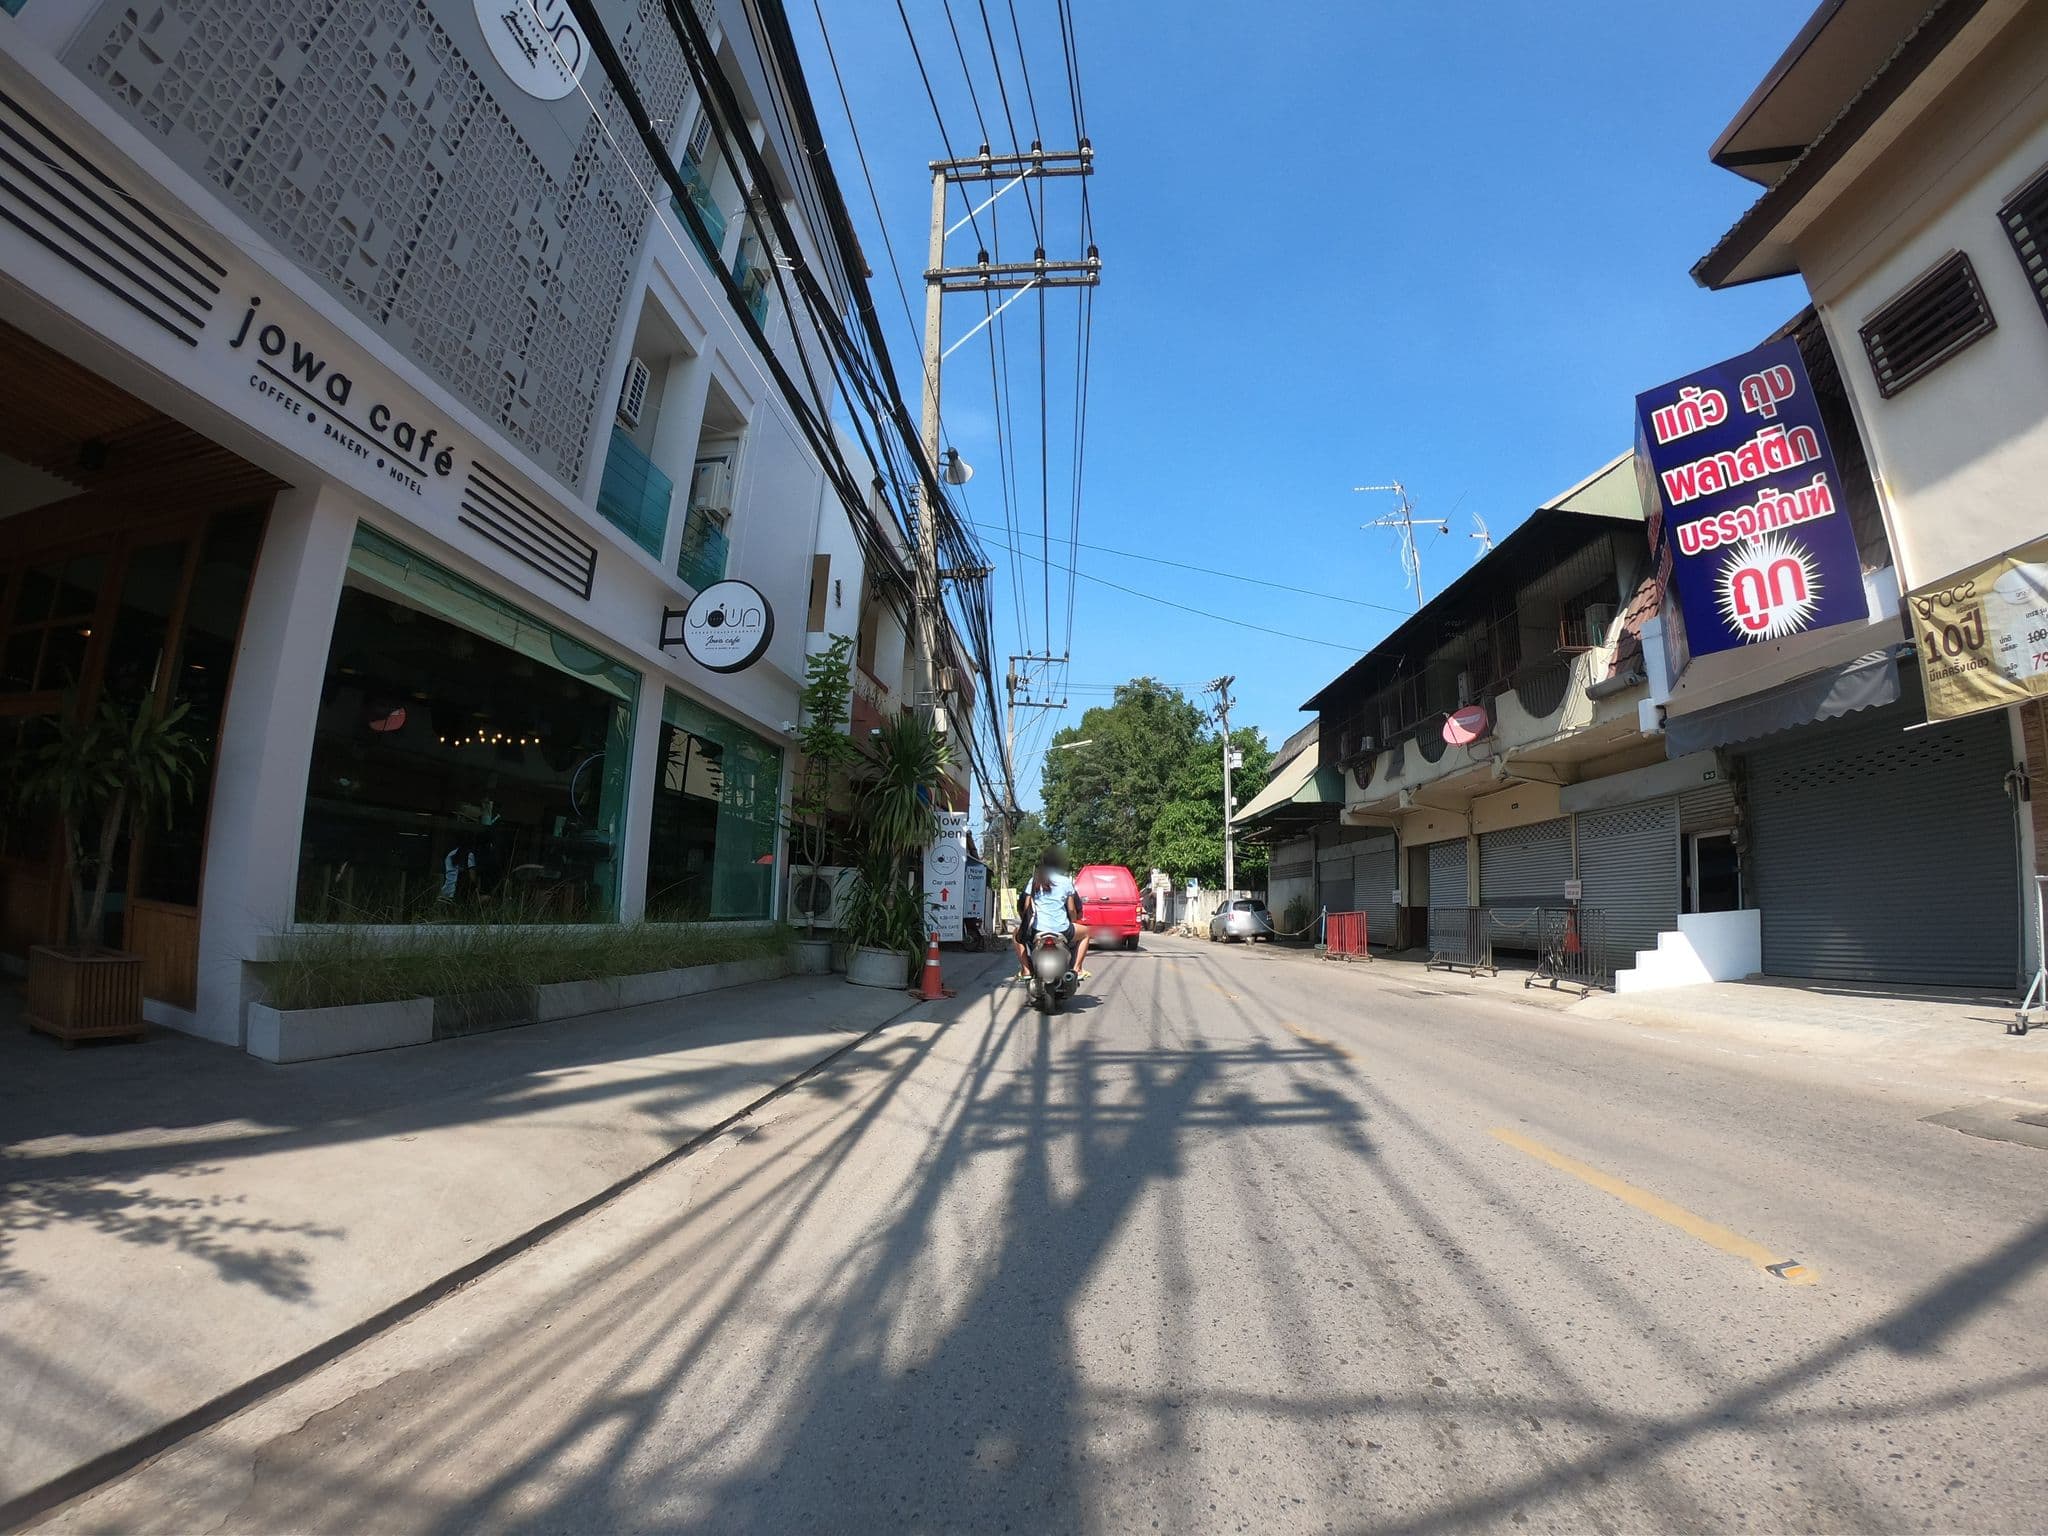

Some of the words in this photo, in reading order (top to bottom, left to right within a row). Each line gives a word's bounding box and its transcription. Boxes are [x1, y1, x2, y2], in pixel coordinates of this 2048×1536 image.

[229, 296, 353, 406] jowa
[369, 403, 456, 476] café
[1653, 388, 1727, 443] แก้ว
[1740, 365, 1795, 418] ถุง
[249, 374, 302, 416] COFFEE
[323, 423, 370, 460] BAKERY
[390, 467, 423, 496] HOTEL
[1662, 424, 1820, 505] พลาสติก
[1678, 473, 1835, 555] บรรจุภัณฑ์
[1732, 557, 1807, 631] ถูก
[1924, 609, 1986, 665] 10ปี
